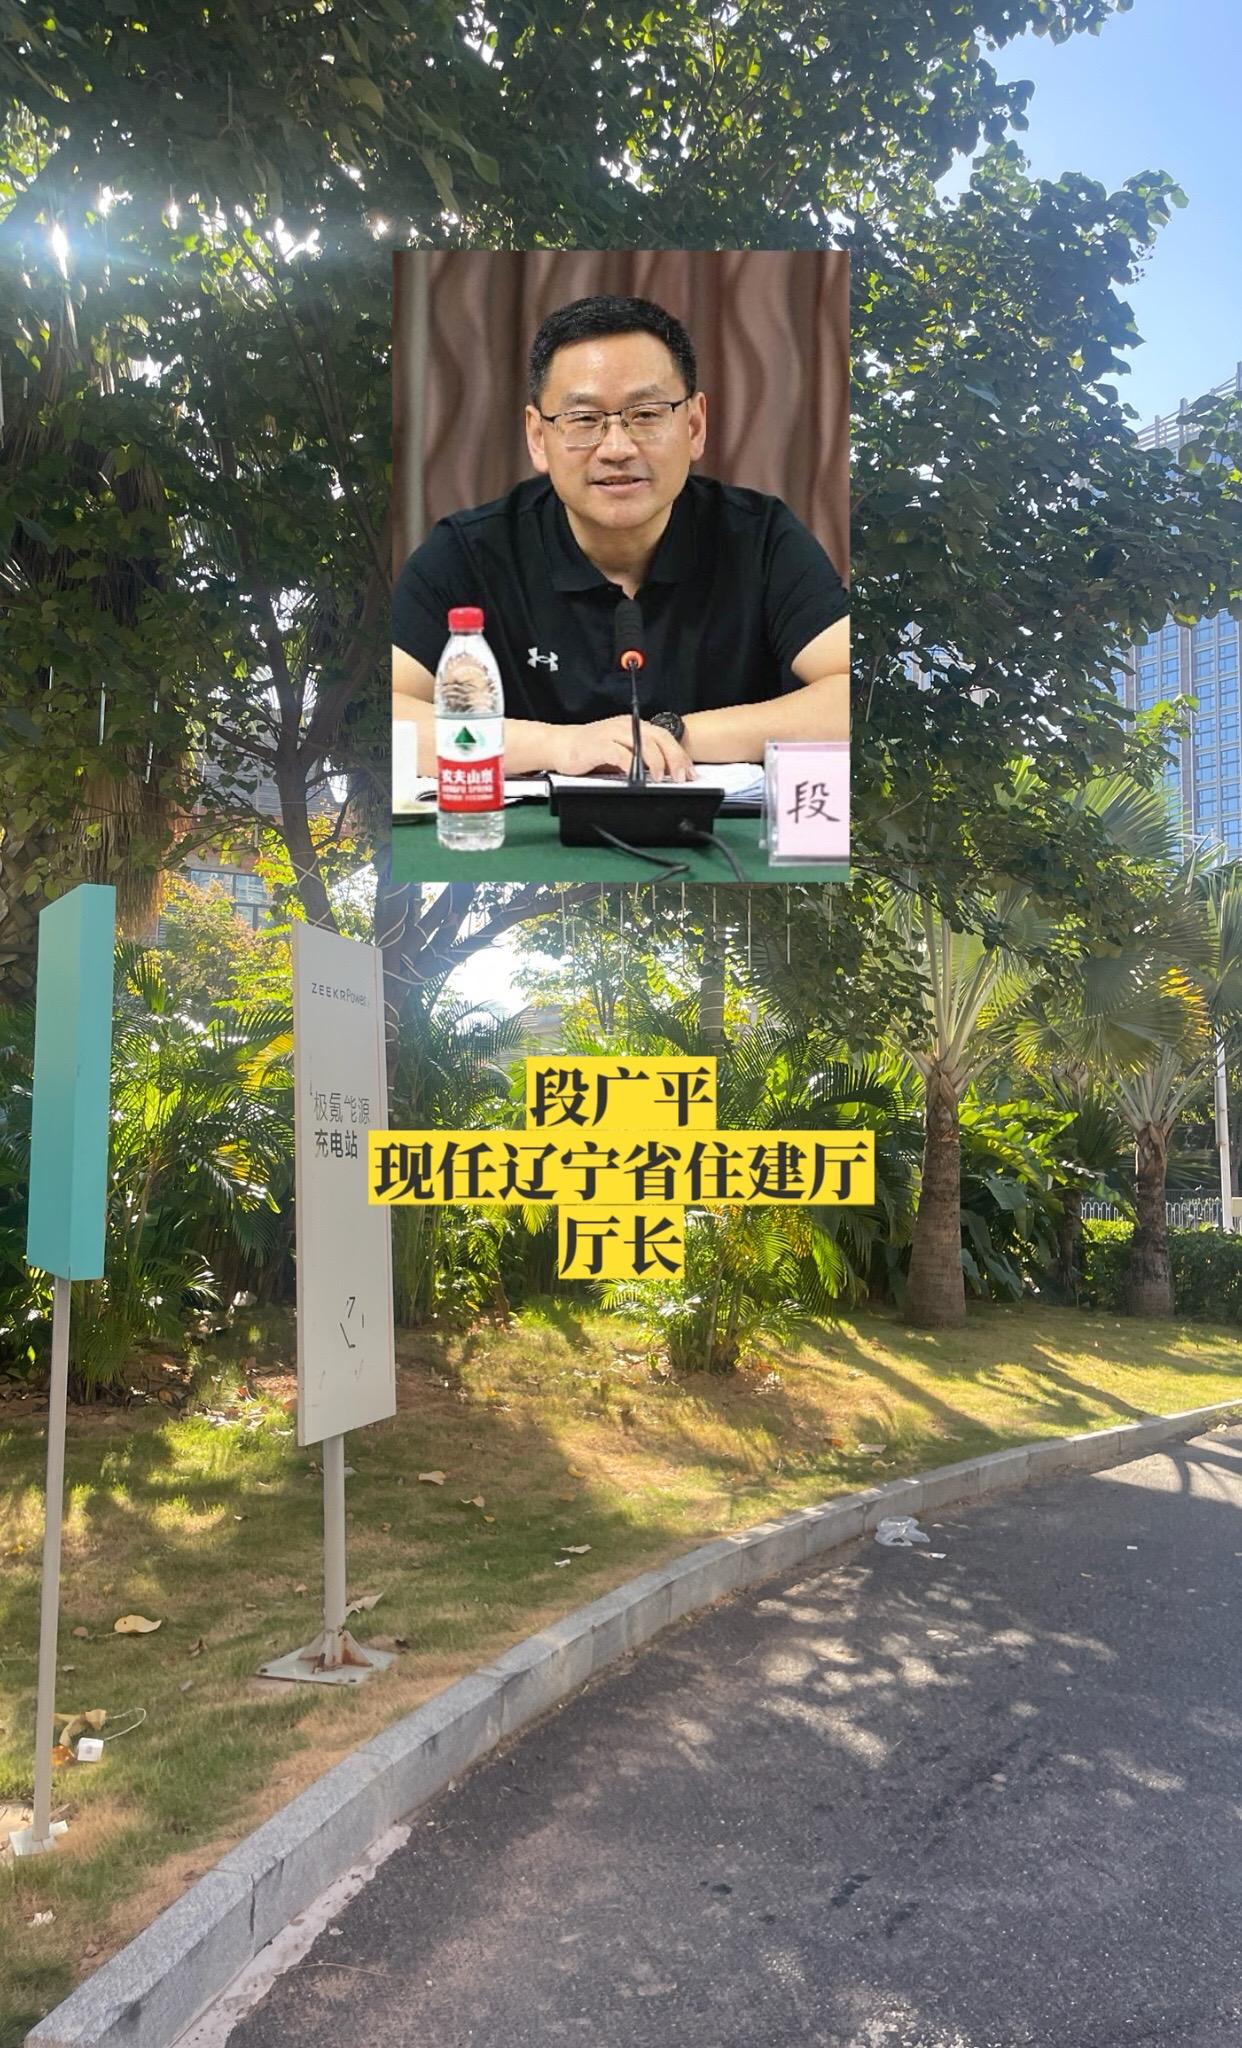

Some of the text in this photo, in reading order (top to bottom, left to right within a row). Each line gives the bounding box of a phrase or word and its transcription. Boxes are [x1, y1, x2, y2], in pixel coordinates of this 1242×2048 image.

[787, 780, 841, 824] 段
[313, 1091, 370, 1125] 极氪能源
[314, 1128, 358, 1159] 充电站
